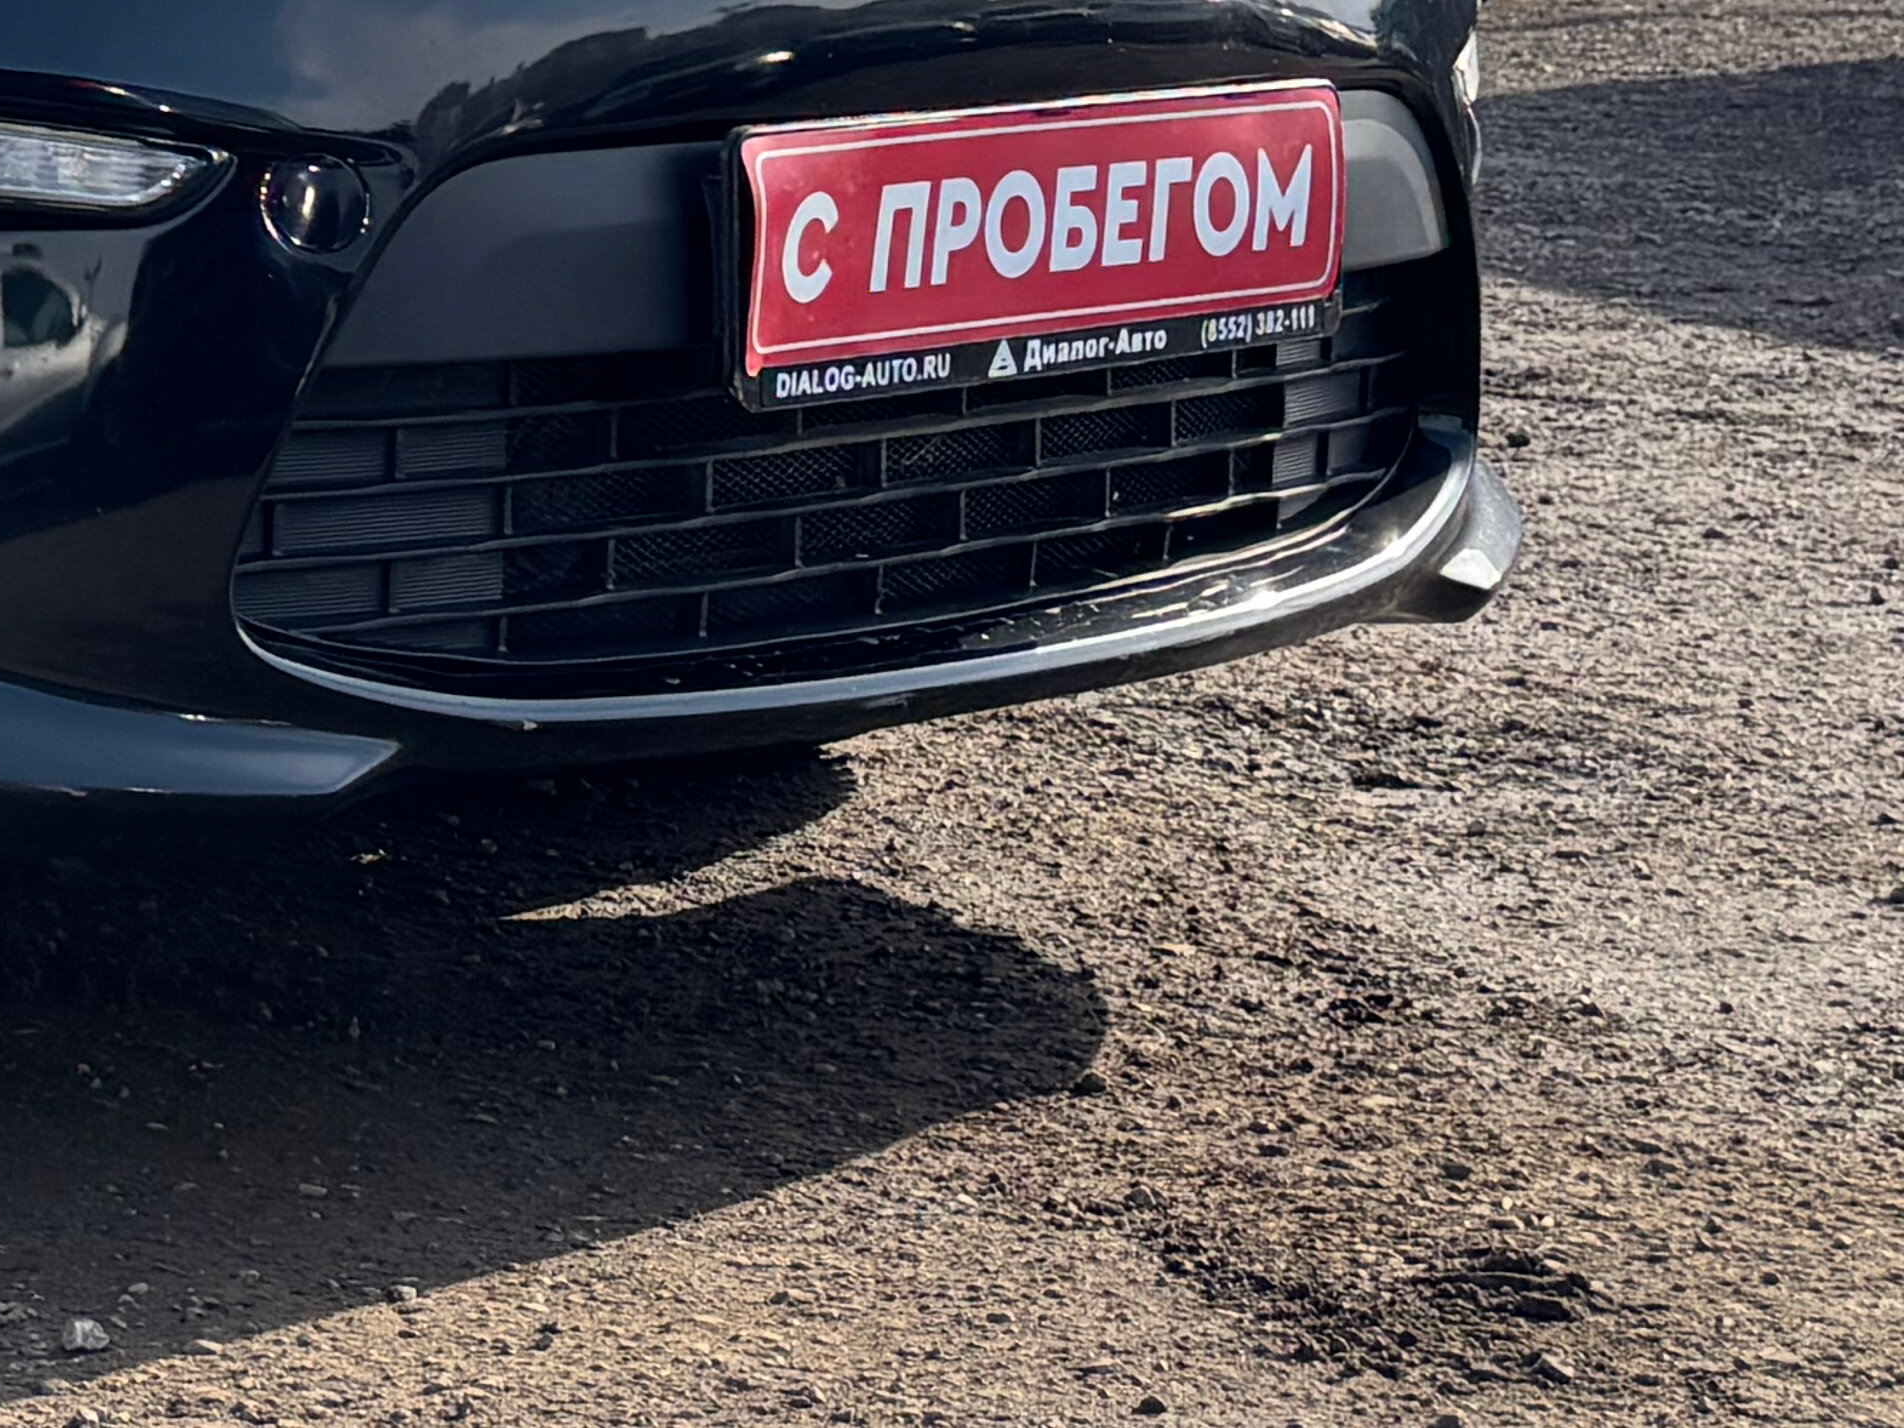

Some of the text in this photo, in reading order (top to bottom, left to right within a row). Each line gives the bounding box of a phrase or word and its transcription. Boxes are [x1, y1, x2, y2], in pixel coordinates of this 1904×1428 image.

[782, 143, 1313, 303] С ПРОБЕГОМ
[1024, 328, 1167, 373] Диалог-Авто
[775, 353, 952, 399] DIALOG-AUTO.RU
